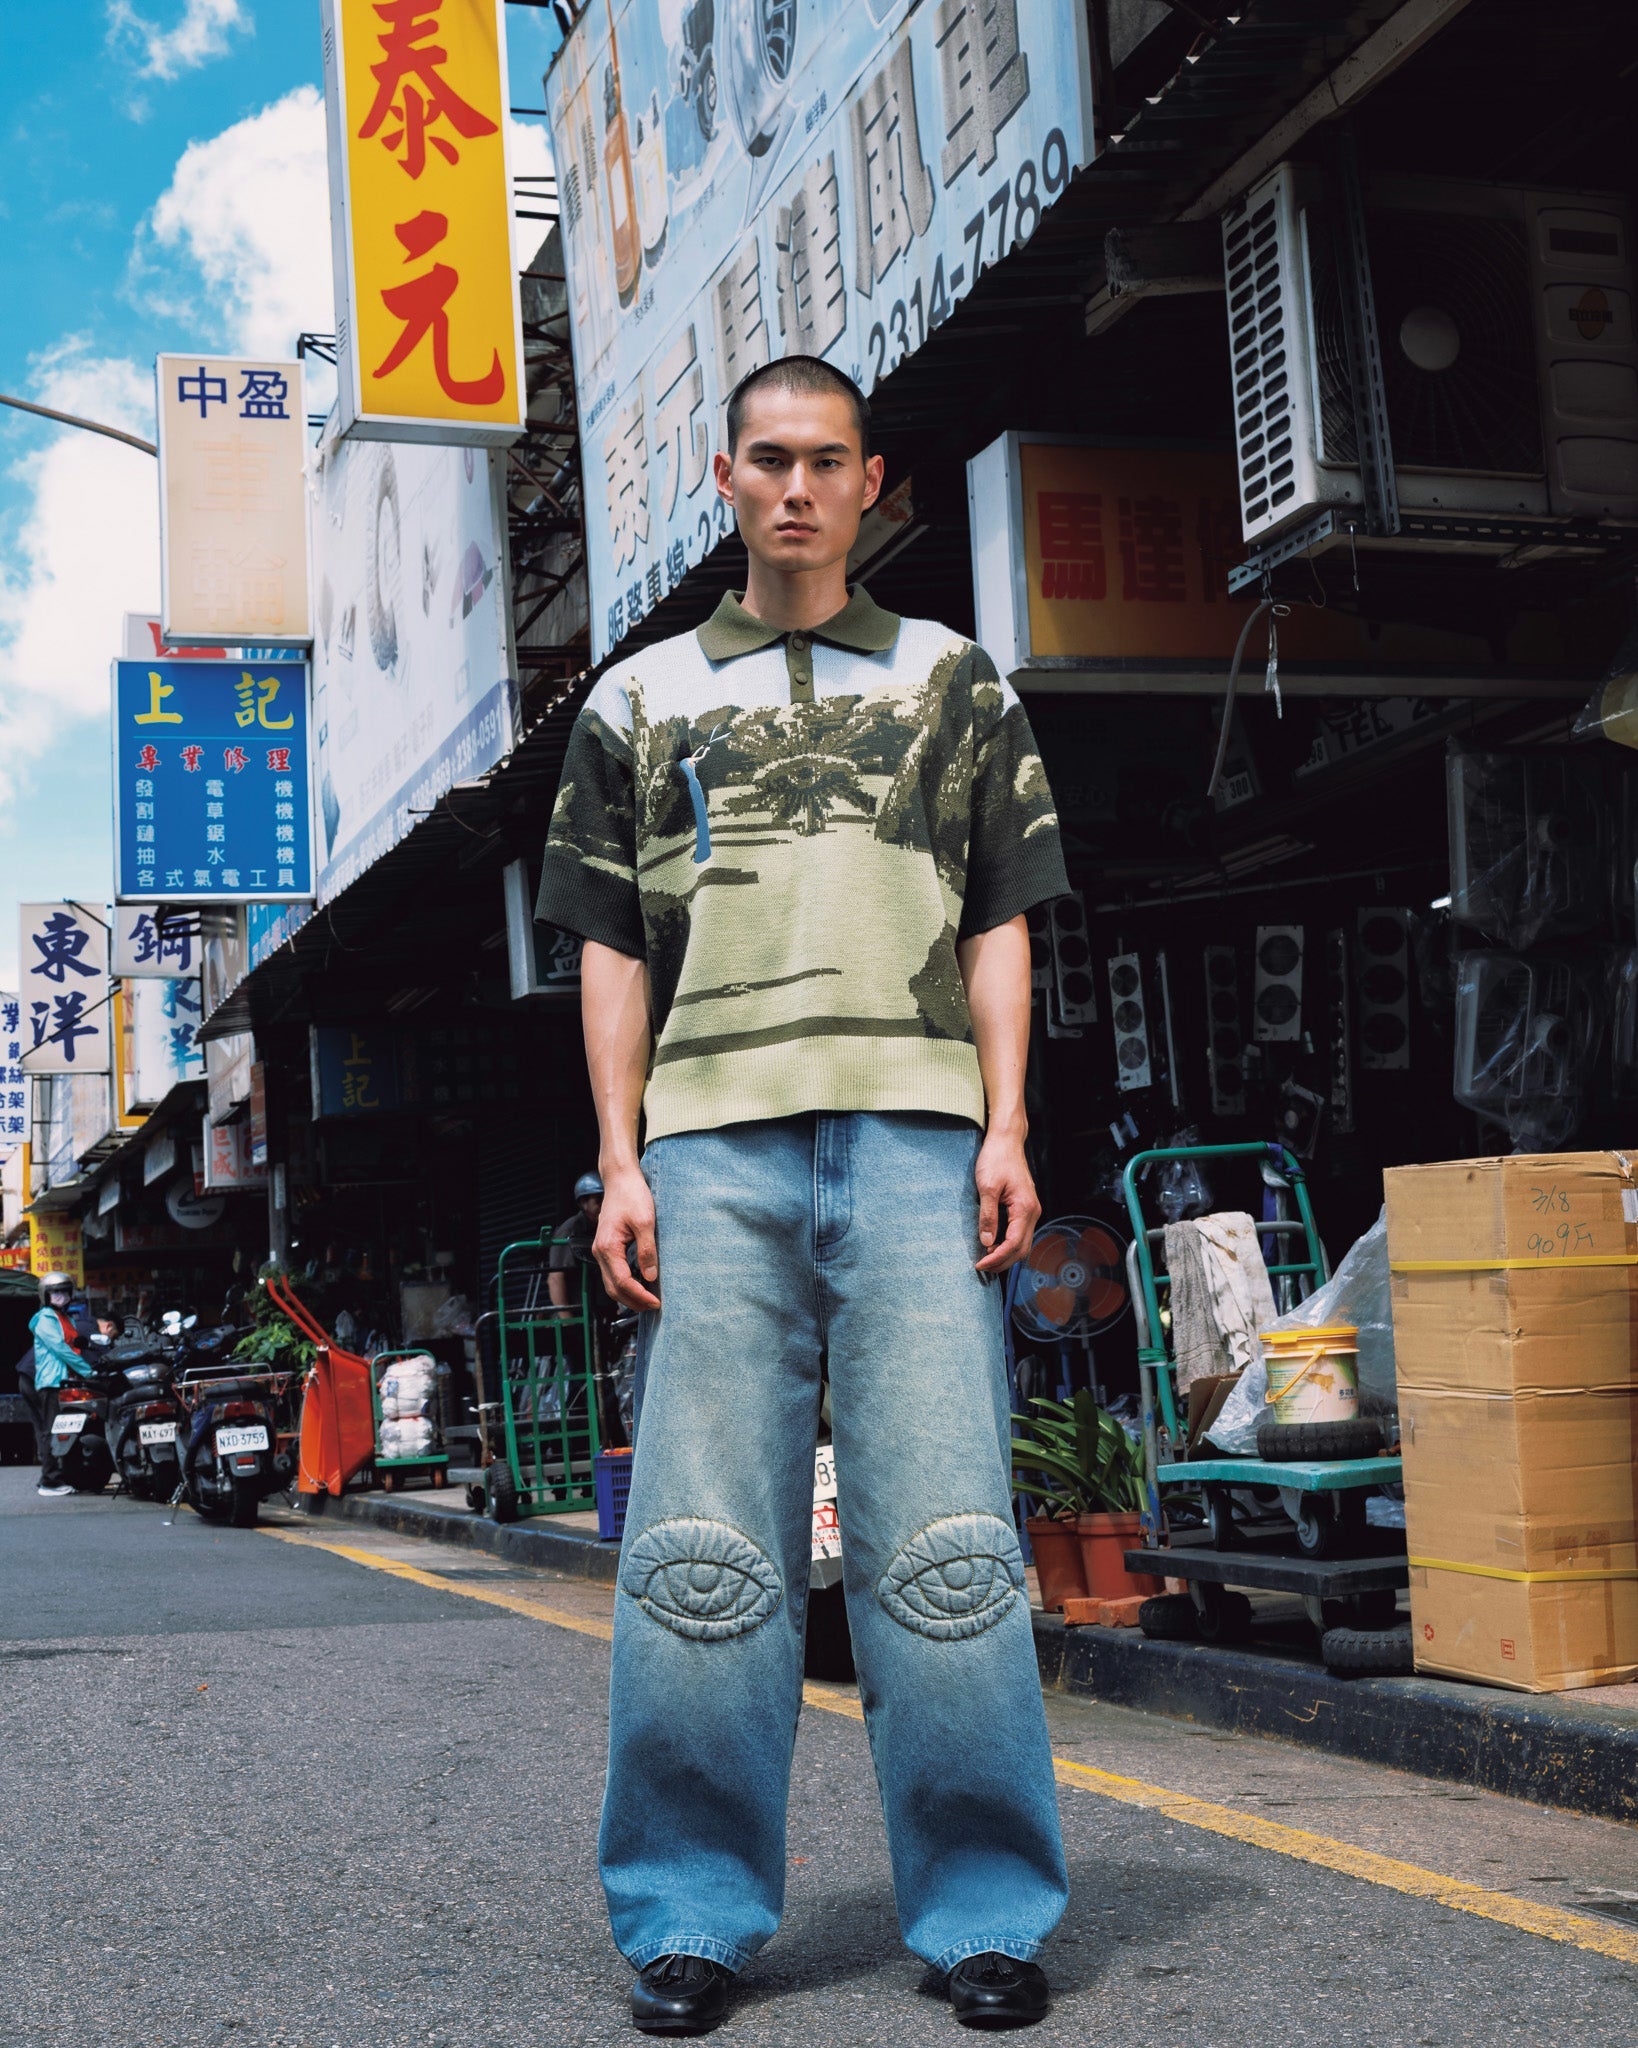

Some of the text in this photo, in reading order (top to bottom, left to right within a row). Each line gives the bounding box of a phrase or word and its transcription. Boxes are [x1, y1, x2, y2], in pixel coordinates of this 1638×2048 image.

[358, 0, 505, 405] 泰元
[178, 366, 290, 419] 中盈
[134, 671, 294, 730] 上記
[136, 744, 291, 774] 專業修理
[136, 779, 293, 798] 發電機
[136, 802, 294, 820] 割草機
[137, 847, 295, 865] 抽水機
[137, 868, 296, 887] 各式氣電工具
[31, 912, 101, 1062] 東洋
[342, 1032, 379, 1109] 上記
[219, 1433, 265, 1448] NXD-3759
